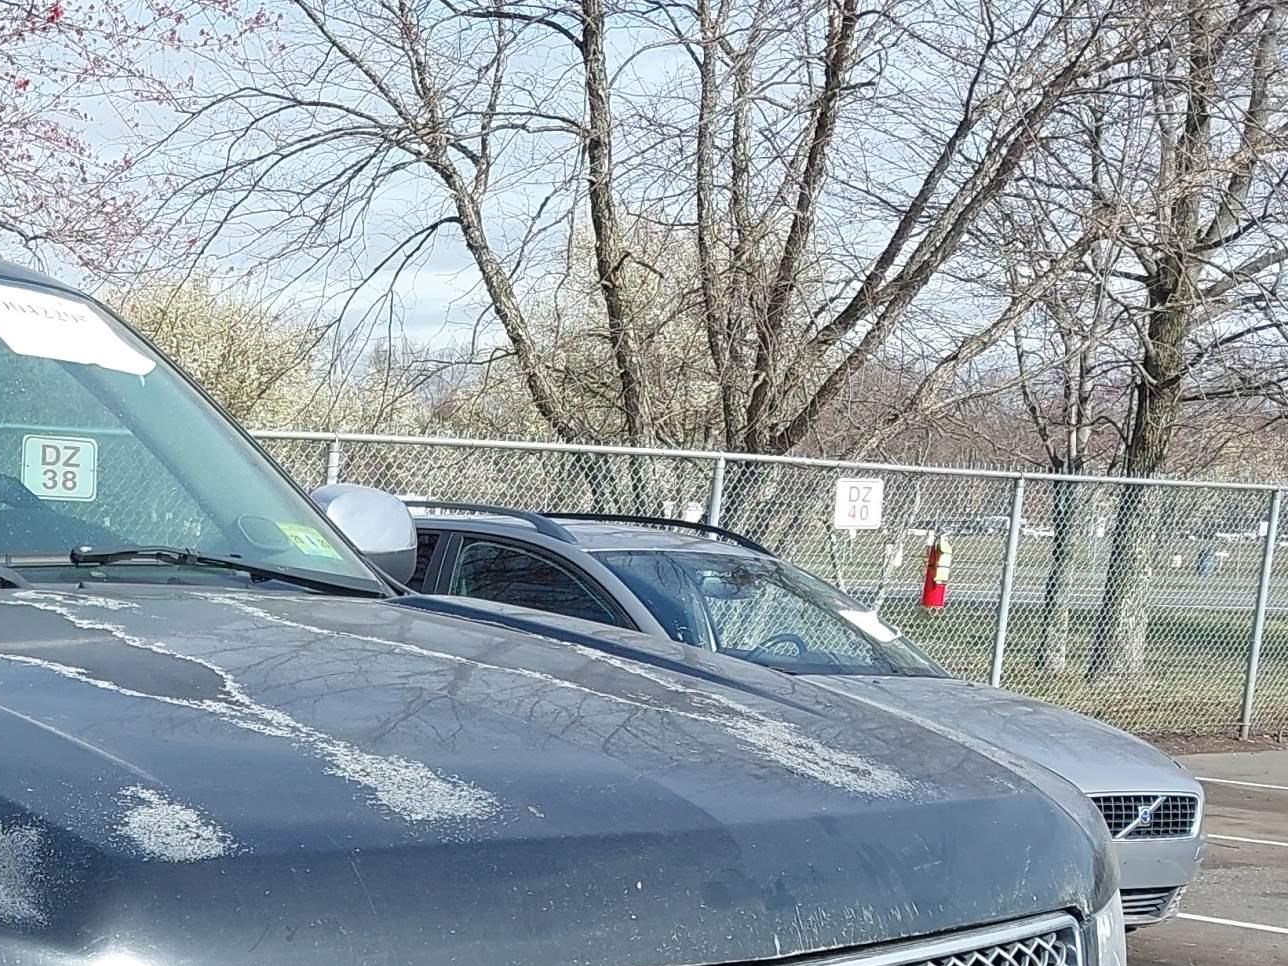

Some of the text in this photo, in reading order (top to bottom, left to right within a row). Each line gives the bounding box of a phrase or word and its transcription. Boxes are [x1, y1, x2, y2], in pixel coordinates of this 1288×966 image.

[41, 444, 81, 468] DZ
[42, 469, 77, 491] 38
[848, 486, 873, 503] DZ
[847, 505, 869, 520] 40
